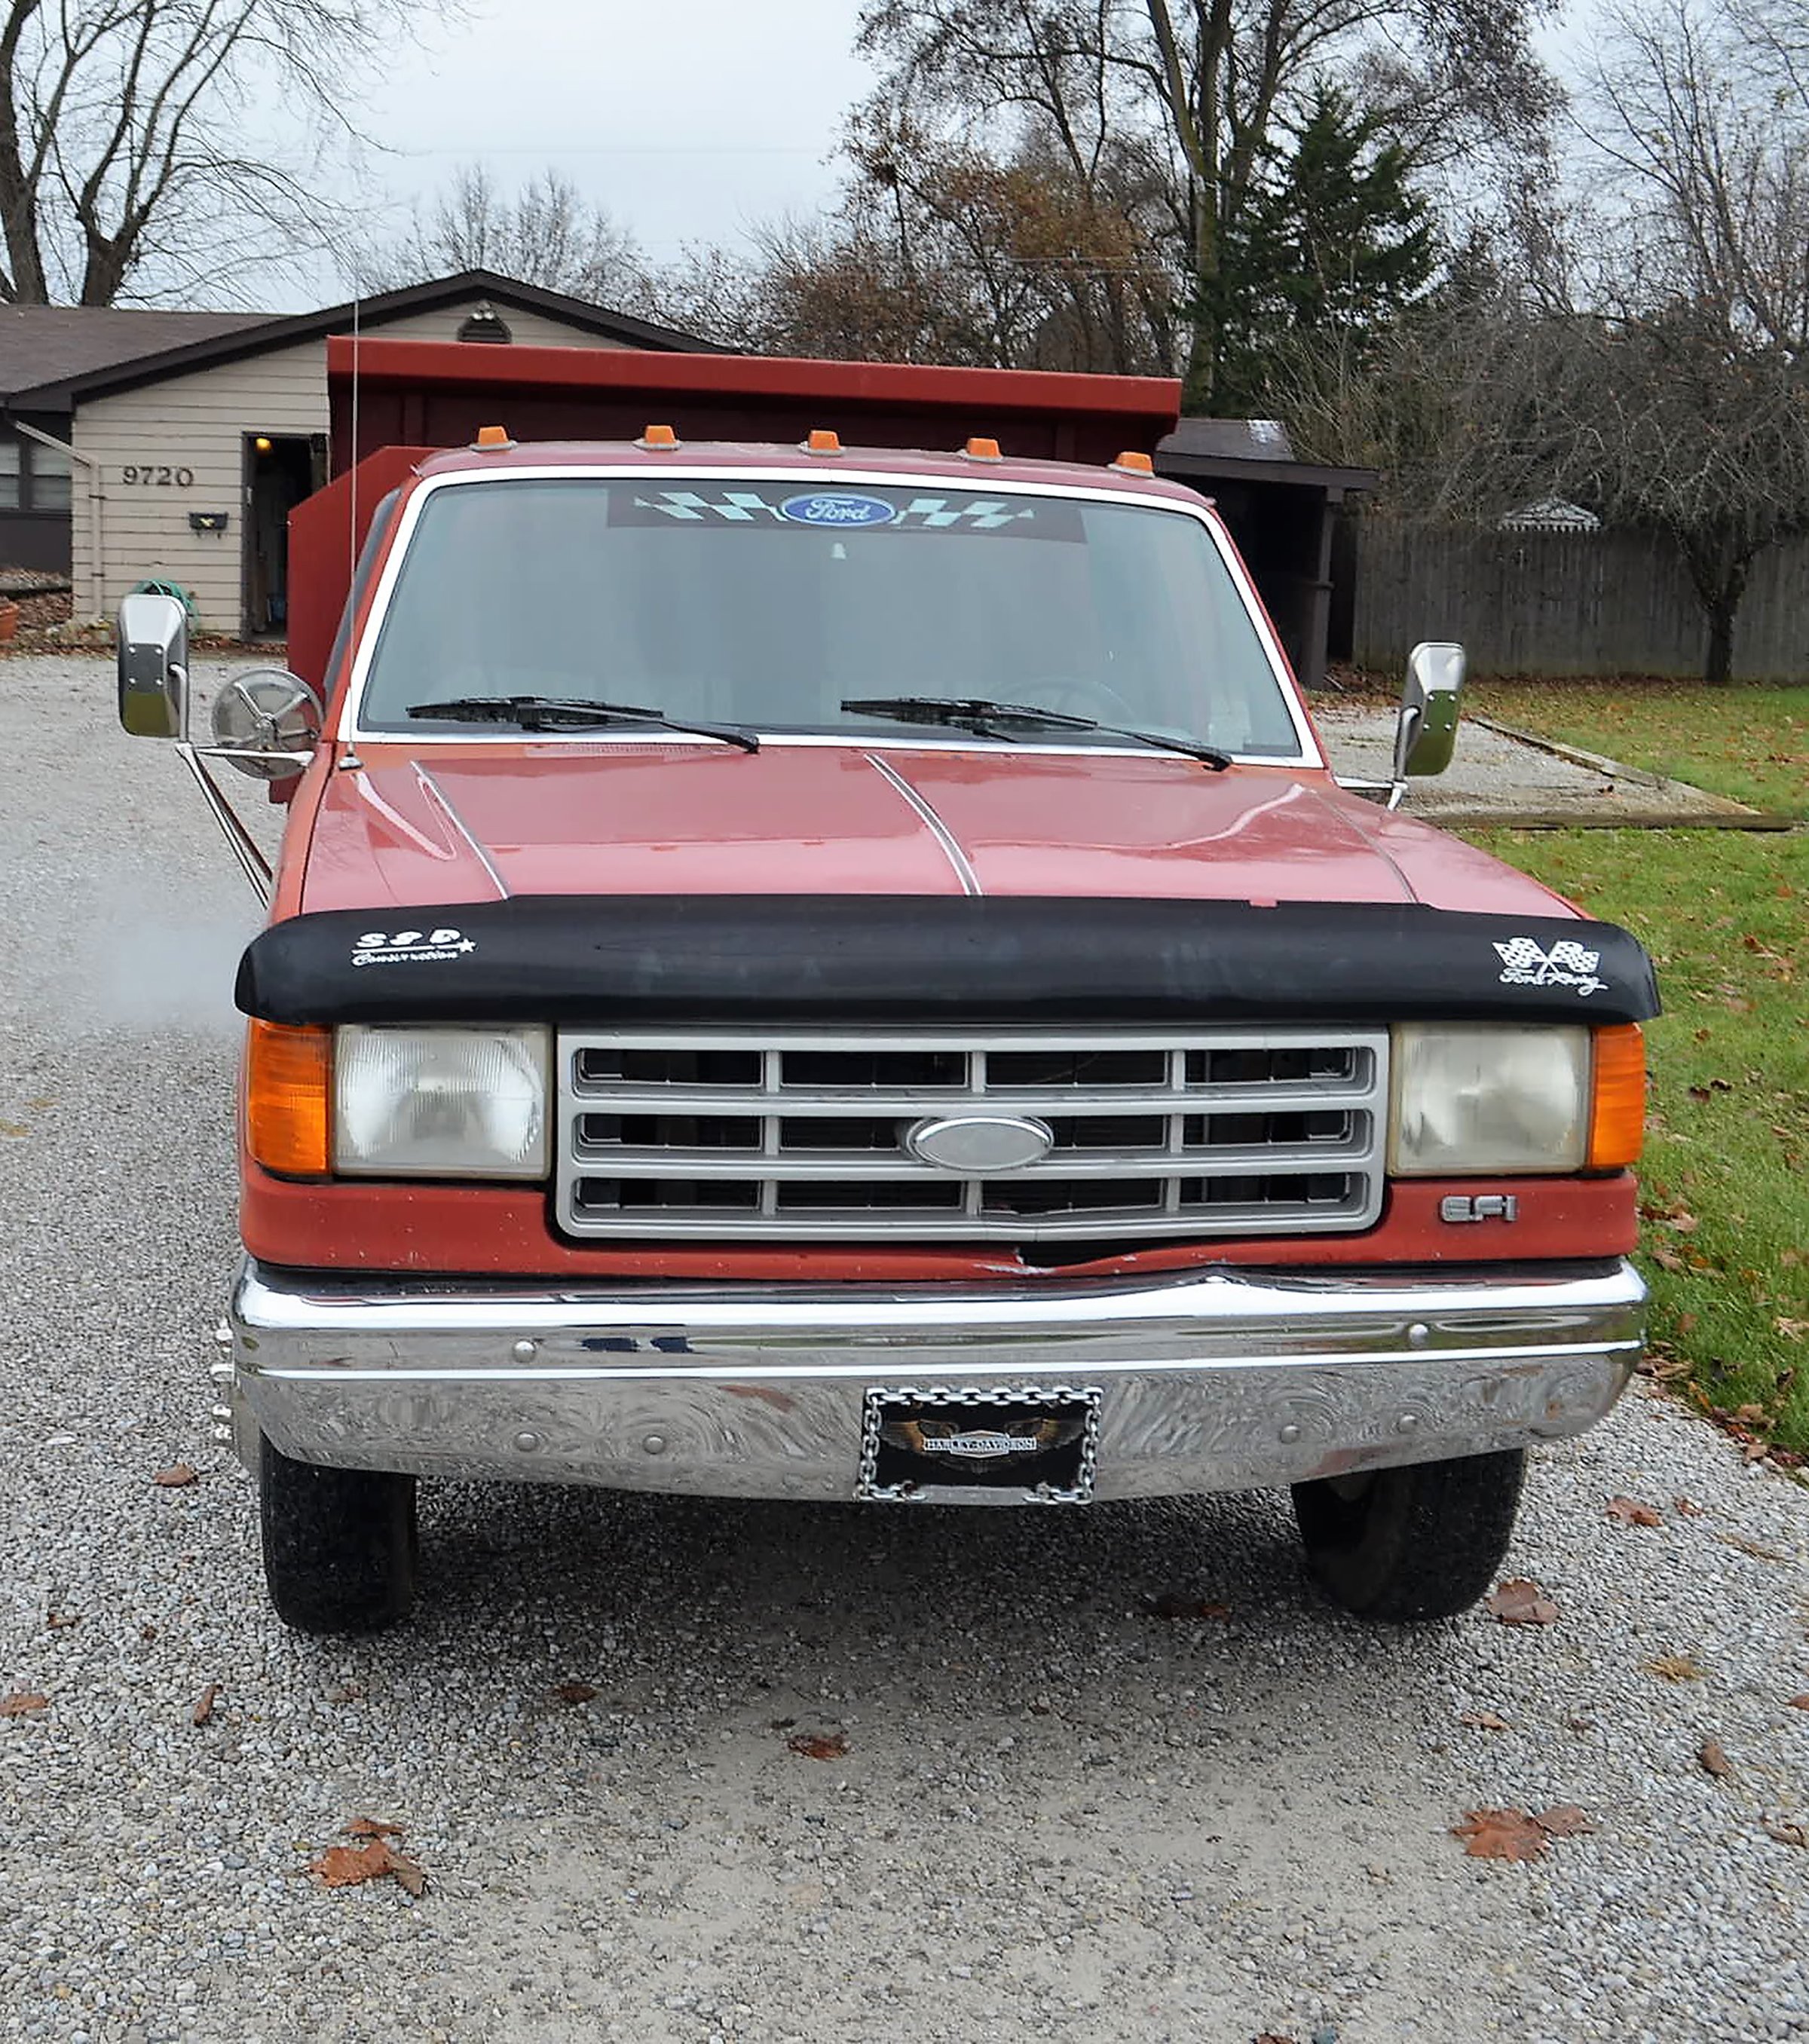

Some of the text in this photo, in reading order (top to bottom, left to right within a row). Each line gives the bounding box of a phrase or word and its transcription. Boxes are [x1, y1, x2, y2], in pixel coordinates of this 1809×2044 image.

[122, 466, 194, 486] 9720
[805, 498, 871, 520] Ford
[1441, 1195, 1518, 1222] EFI
